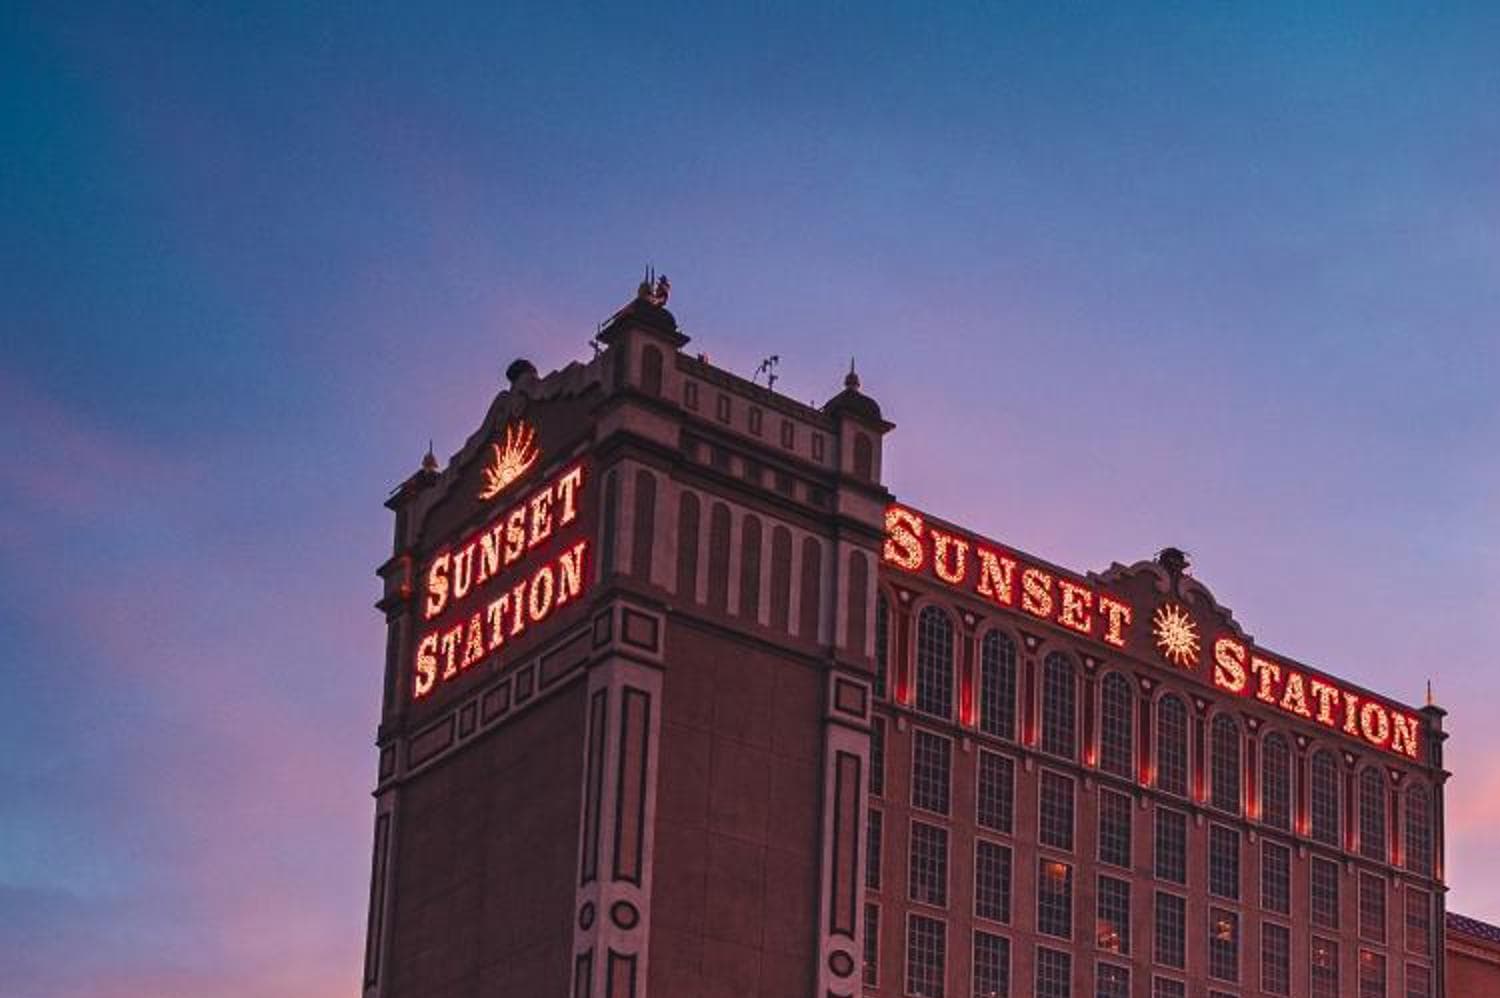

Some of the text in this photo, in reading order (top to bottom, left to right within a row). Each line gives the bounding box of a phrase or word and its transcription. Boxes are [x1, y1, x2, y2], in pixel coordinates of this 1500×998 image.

[413, 541, 588, 698] STATION
[426, 465, 582, 619] SUNSET
[882, 504, 1420, 760] SUNSET STATION
